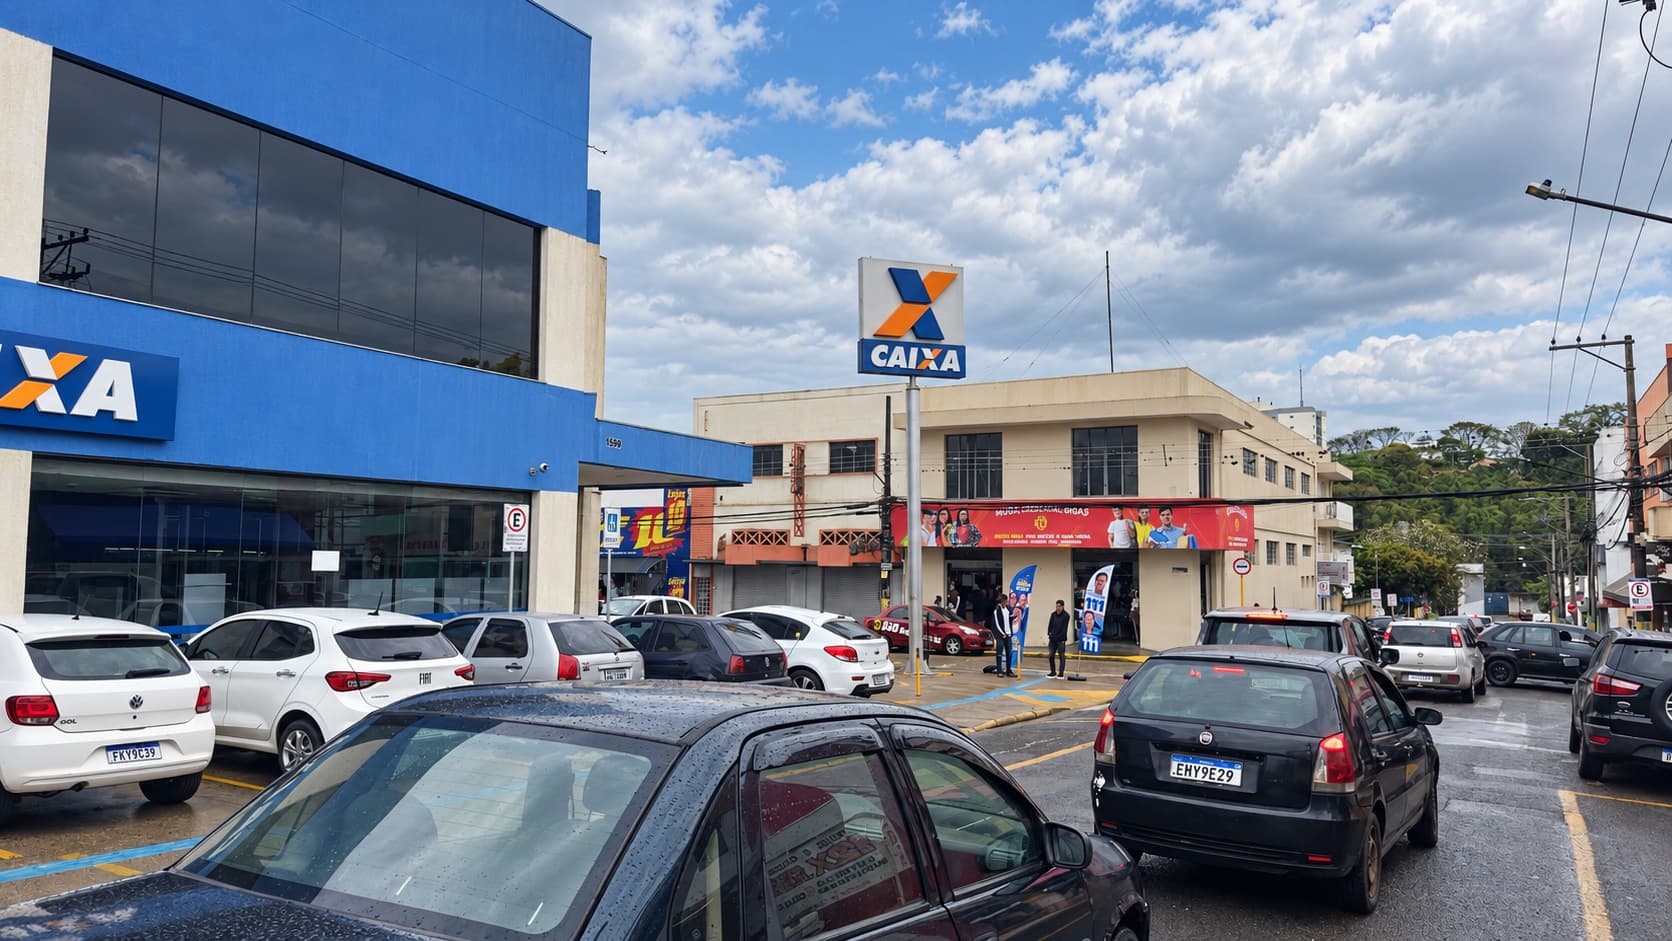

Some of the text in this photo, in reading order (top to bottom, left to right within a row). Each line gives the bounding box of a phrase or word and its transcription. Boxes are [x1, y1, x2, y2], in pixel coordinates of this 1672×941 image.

[871, 344, 960, 372] CAIXA
[513, 512, 521, 528] E
[1085, 597, 1105, 613] 111
[1082, 636, 1099, 653] 111
[419, 672, 432, 686] FIAT
[112, 746, 156, 762] FKY9C39
[1176, 763, 1233, 782] EHY9E29
